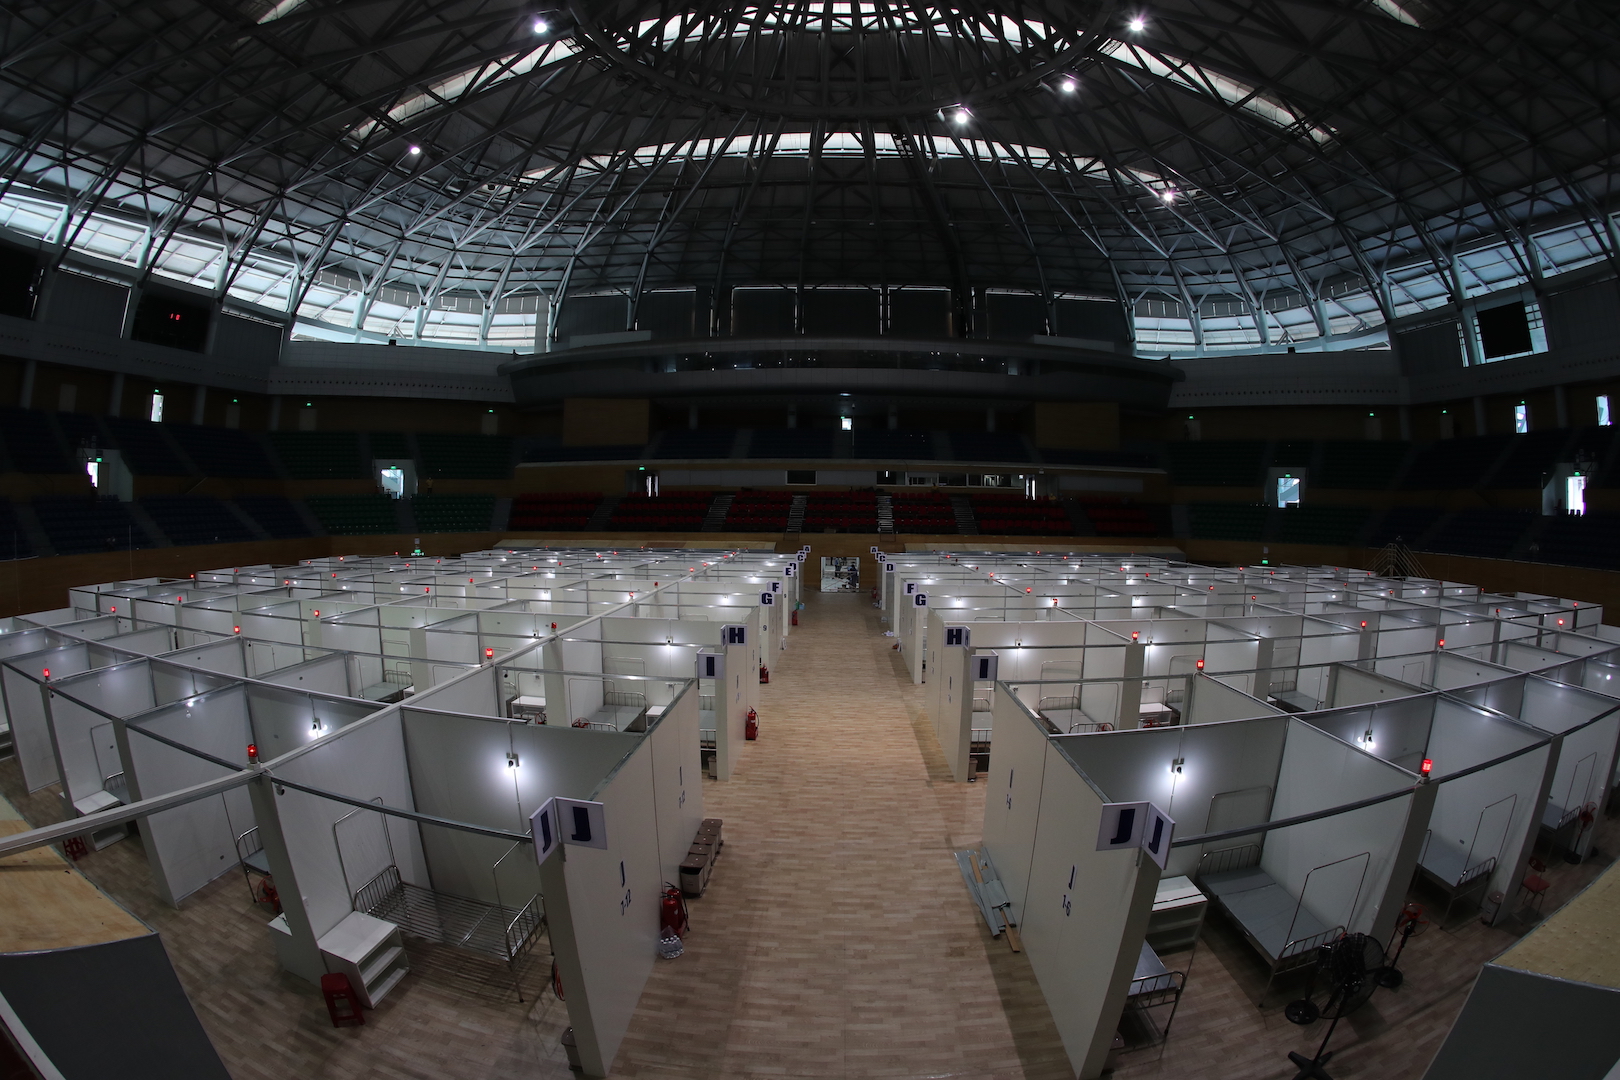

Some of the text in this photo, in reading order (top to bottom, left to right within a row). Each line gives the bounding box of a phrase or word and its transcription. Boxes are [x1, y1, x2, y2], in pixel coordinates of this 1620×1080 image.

[786, 568, 792, 576] E
[886, 564, 894, 572] D
[772, 582, 780, 592] F
[907, 584, 914, 594] F
[762, 592, 772, 604] G
[916, 594, 926, 606] G
[729, 628, 744, 644] H
[947, 628, 962, 645] H
[706, 656, 714, 676] I
[979, 658, 988, 678] I
[541, 810, 552, 854] J
[572, 806, 592, 842] J
[1110, 808, 1136, 845] J
[1148, 815, 1164, 854] J
